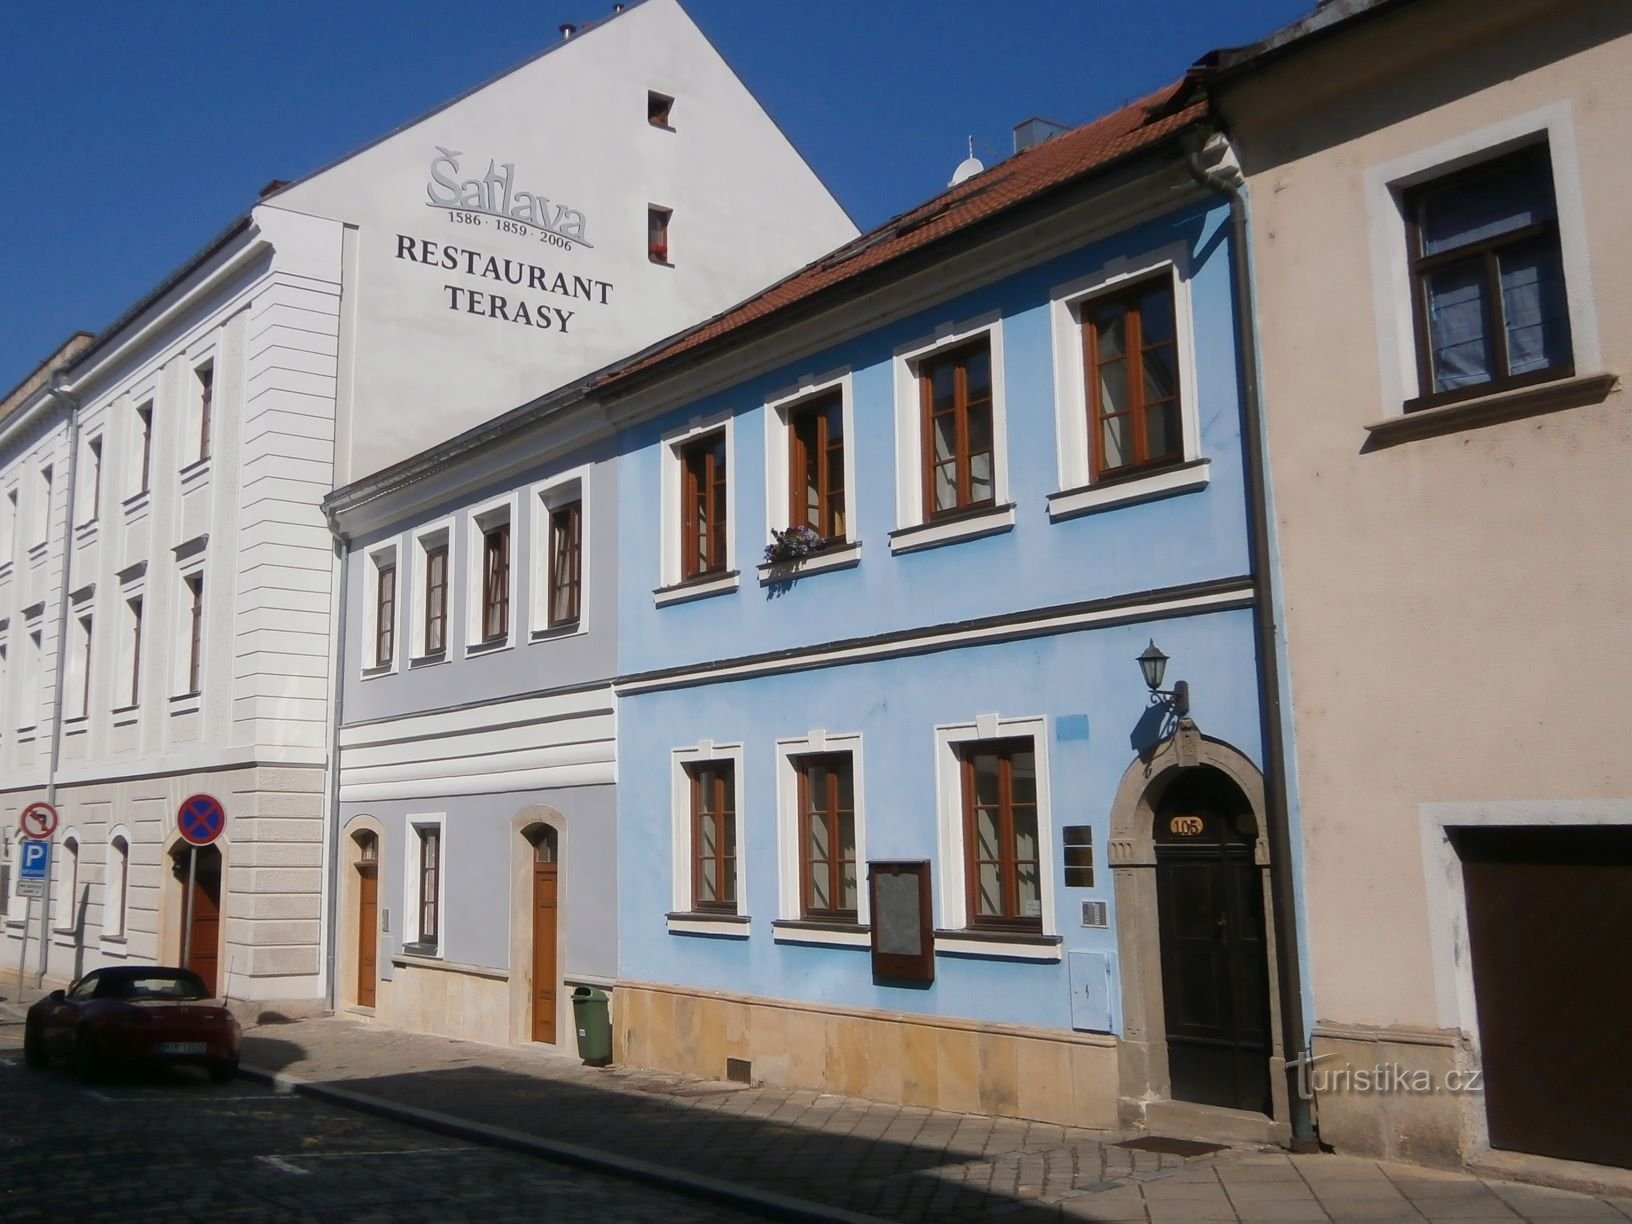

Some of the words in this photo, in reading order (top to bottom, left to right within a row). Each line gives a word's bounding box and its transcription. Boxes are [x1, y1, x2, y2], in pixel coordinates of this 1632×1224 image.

[426, 146, 588, 241] Šatlava
[448, 211, 482, 226] 1586
[495, 219, 528, 236] 1859
[539, 231, 573, 252] 2006
[395, 233, 614, 305] RESTAURANT
[443, 284, 576, 334] TERASY
[1174, 820, 1199, 836] 105
[26, 845, 44, 867] P
